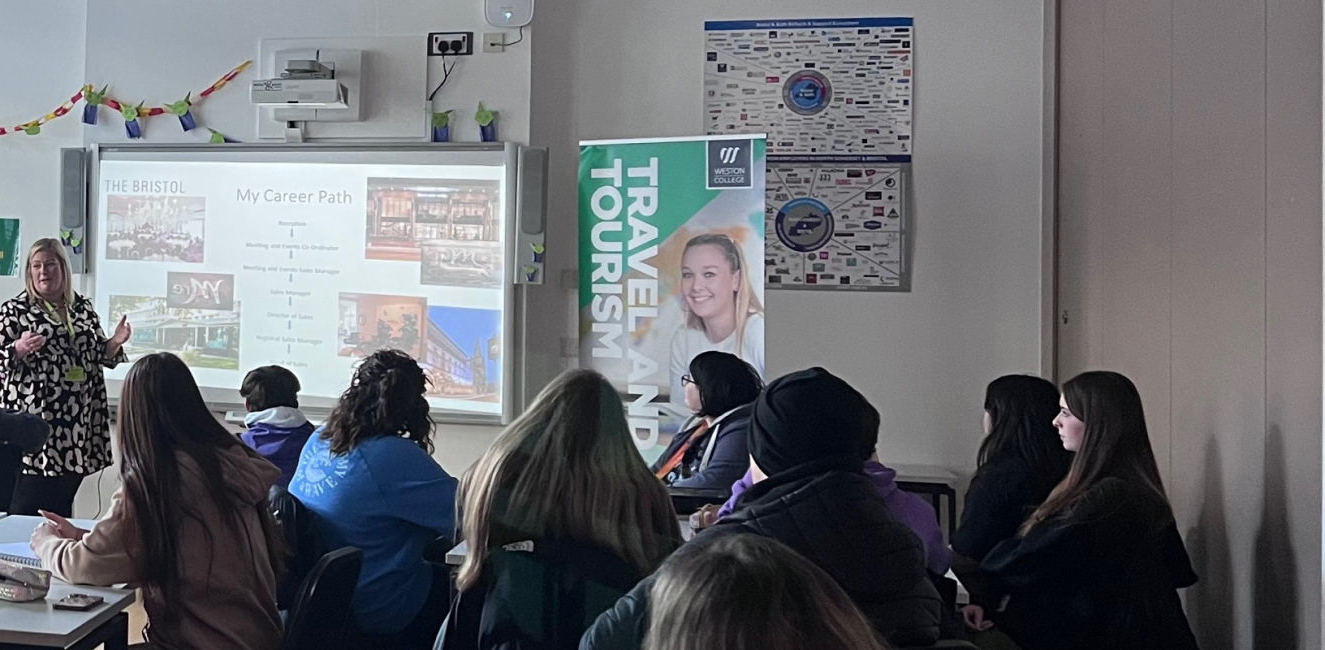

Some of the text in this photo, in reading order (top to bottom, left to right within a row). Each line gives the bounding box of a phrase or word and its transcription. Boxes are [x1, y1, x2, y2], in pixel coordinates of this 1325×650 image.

[105, 180, 185, 193] THE BRISTOL
[236, 189, 352, 204] My Career Path
[591, 158, 623, 358] TOURISM
[627, 157, 659, 450] TRAVEL AND
